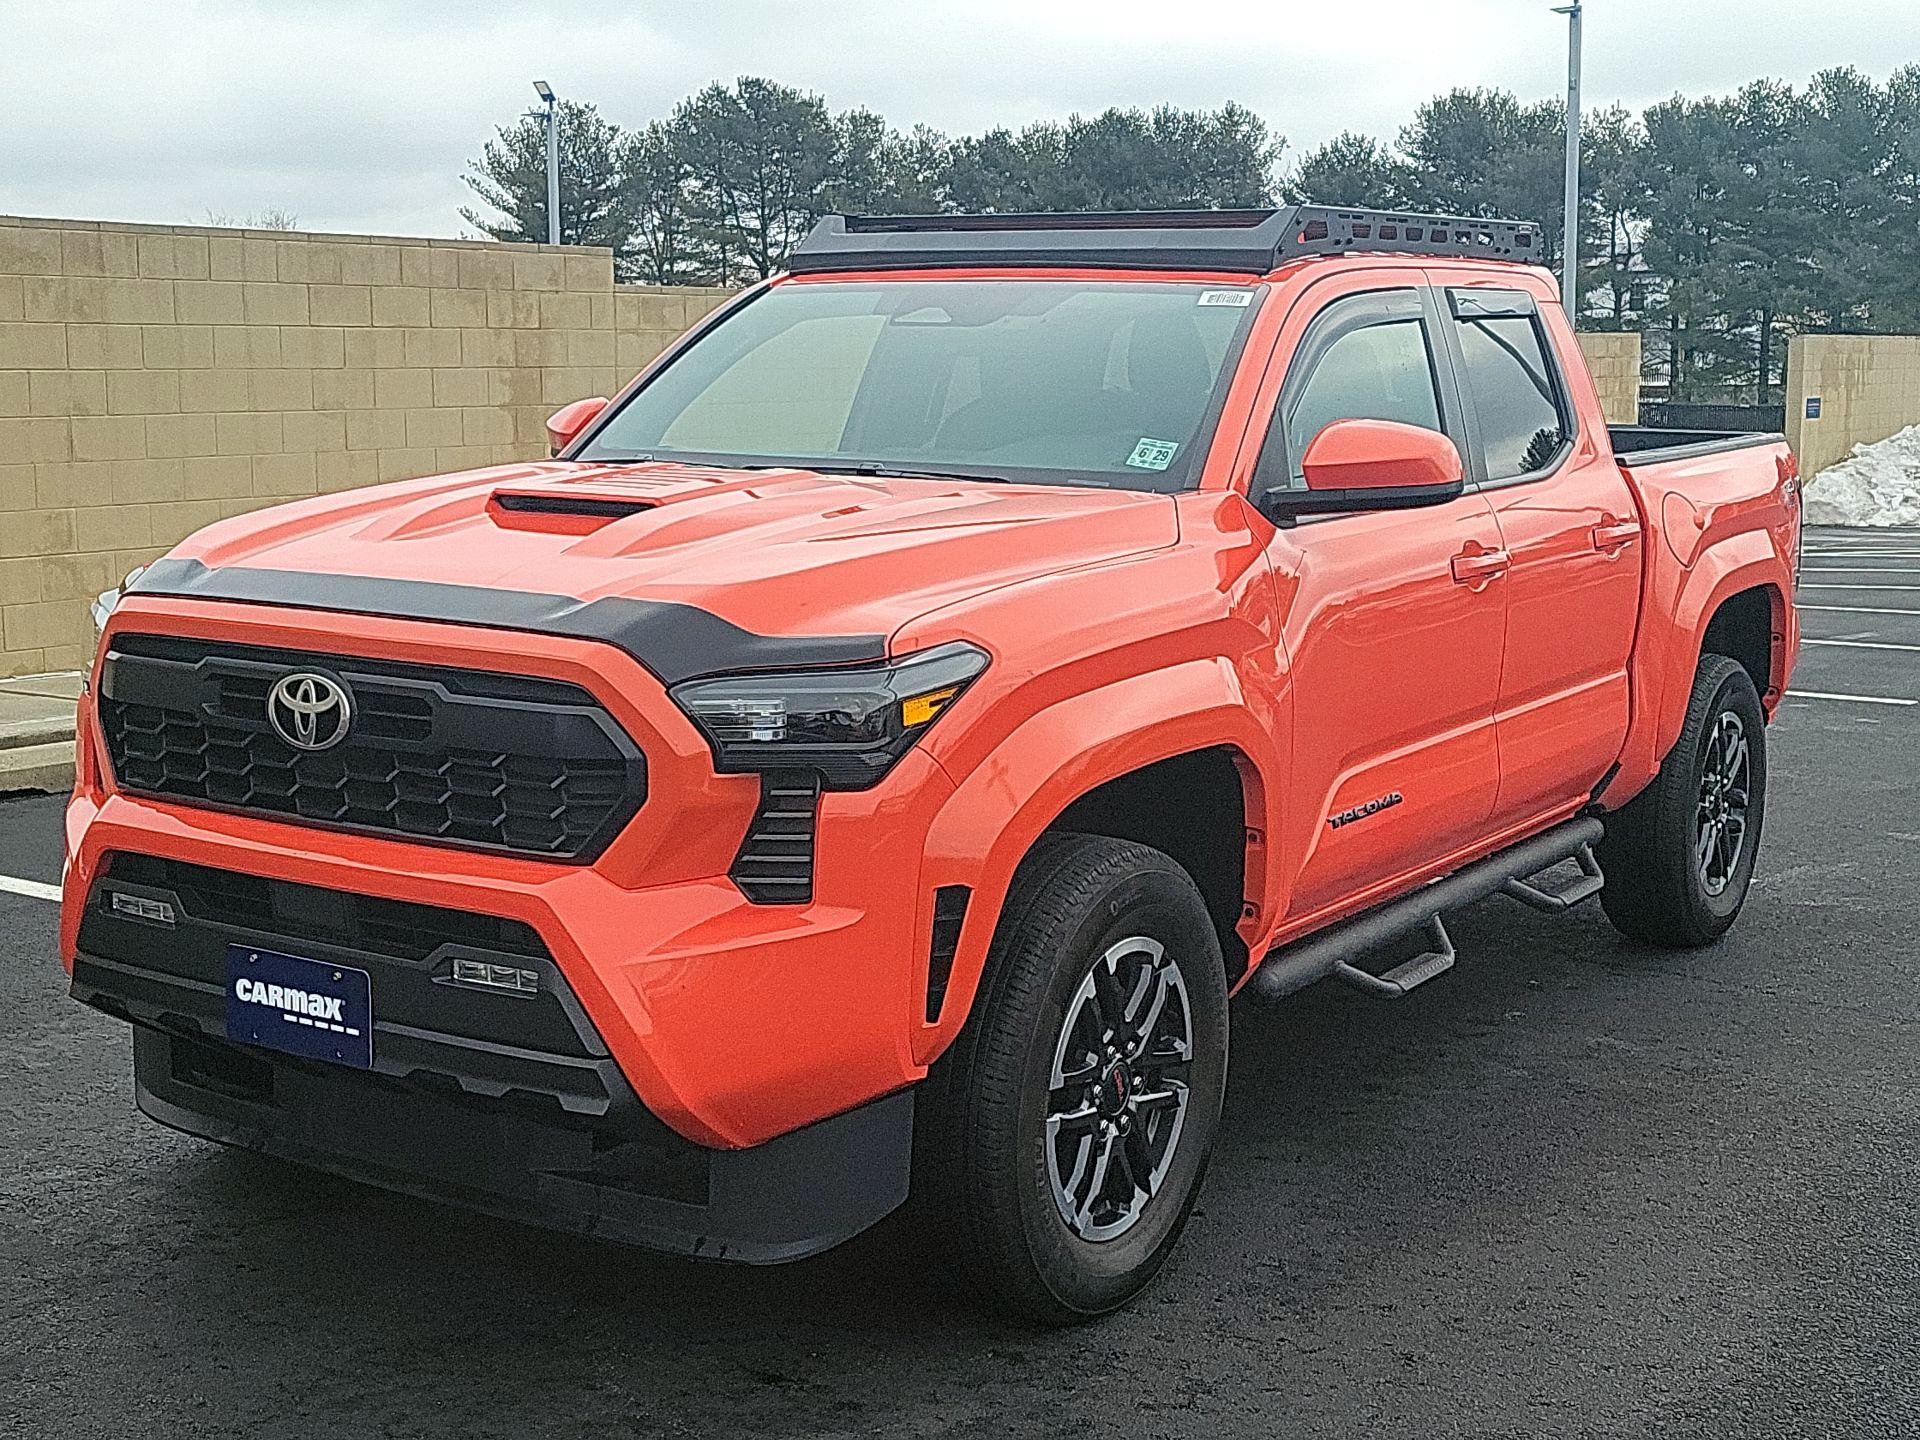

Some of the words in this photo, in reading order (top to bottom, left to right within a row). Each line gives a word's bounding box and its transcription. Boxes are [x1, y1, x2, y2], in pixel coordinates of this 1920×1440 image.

[1138, 447, 1149, 458] 6
[1152, 450, 1169, 461] 29
[1327, 791, 1403, 830] TACOMA
